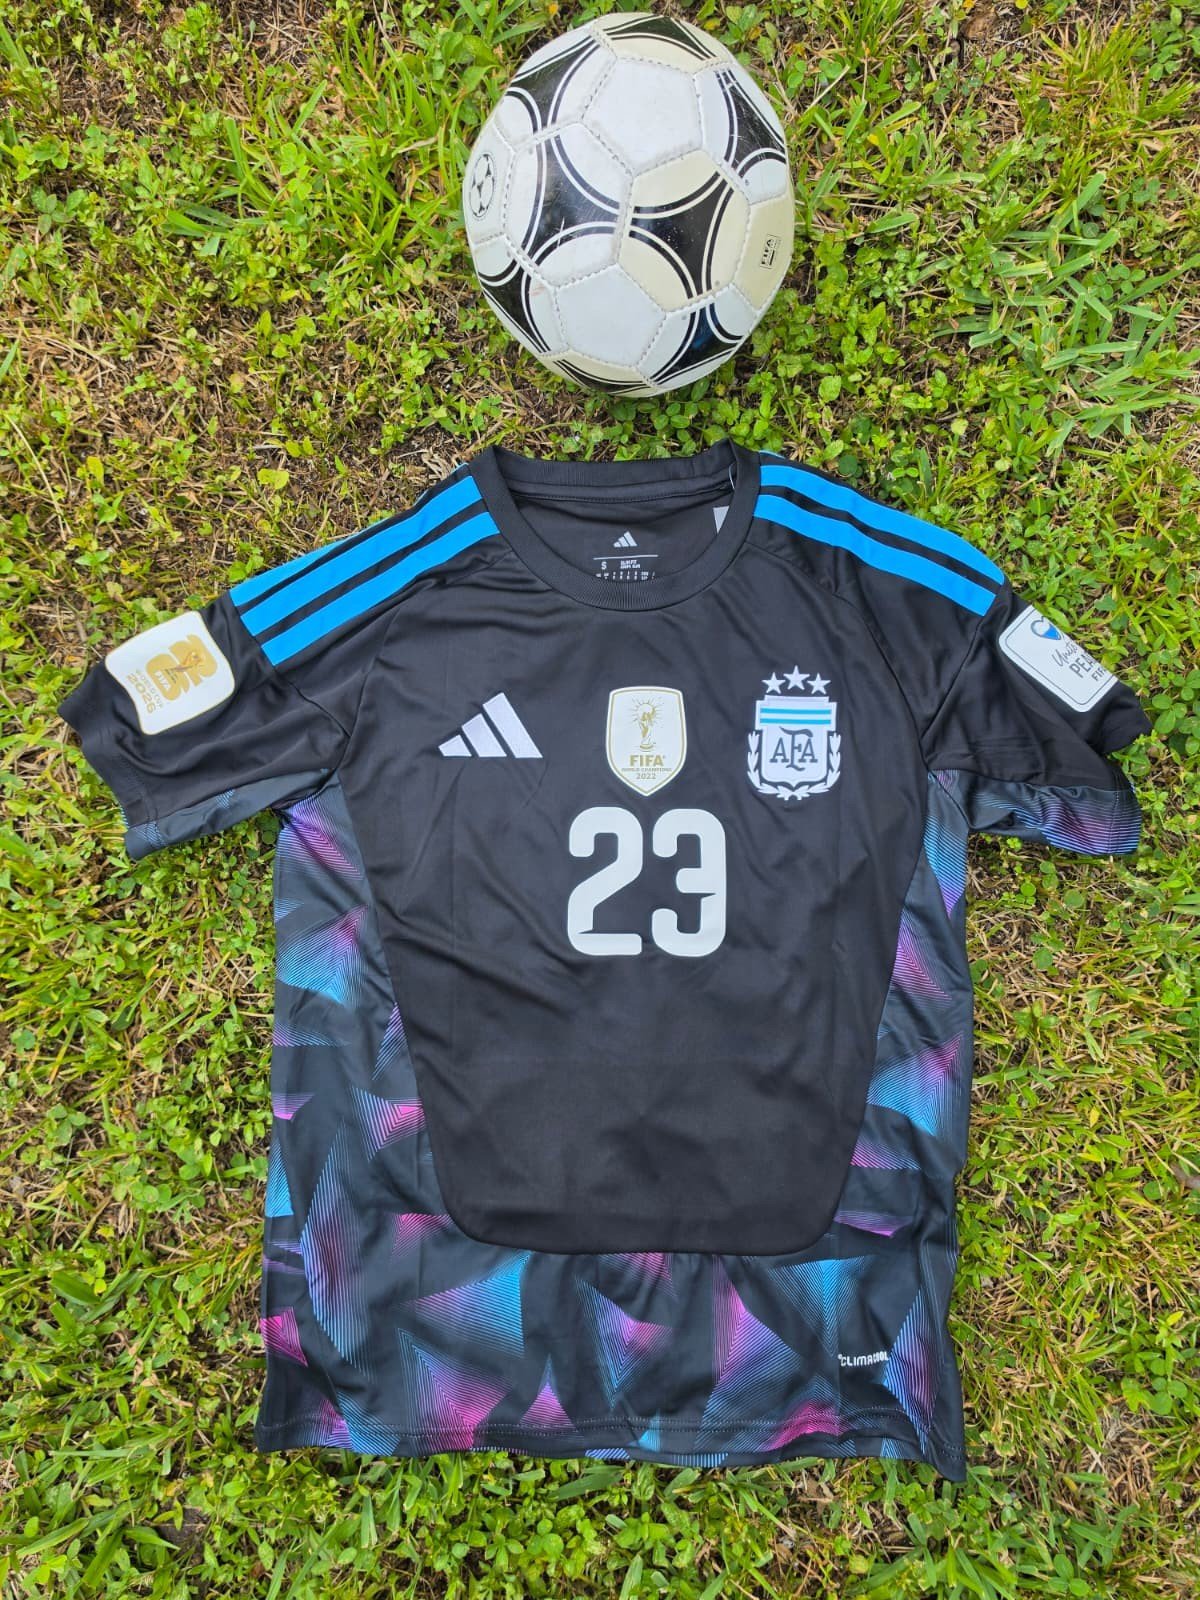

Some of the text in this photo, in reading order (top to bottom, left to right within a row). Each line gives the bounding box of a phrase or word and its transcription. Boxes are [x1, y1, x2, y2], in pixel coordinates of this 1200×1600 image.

[601, 561, 607, 570] S
[126, 672, 156, 714] 2026
[629, 755, 664, 766] FIFA
[769, 726, 818, 772] AFA
[567, 806, 726, 957] 23
